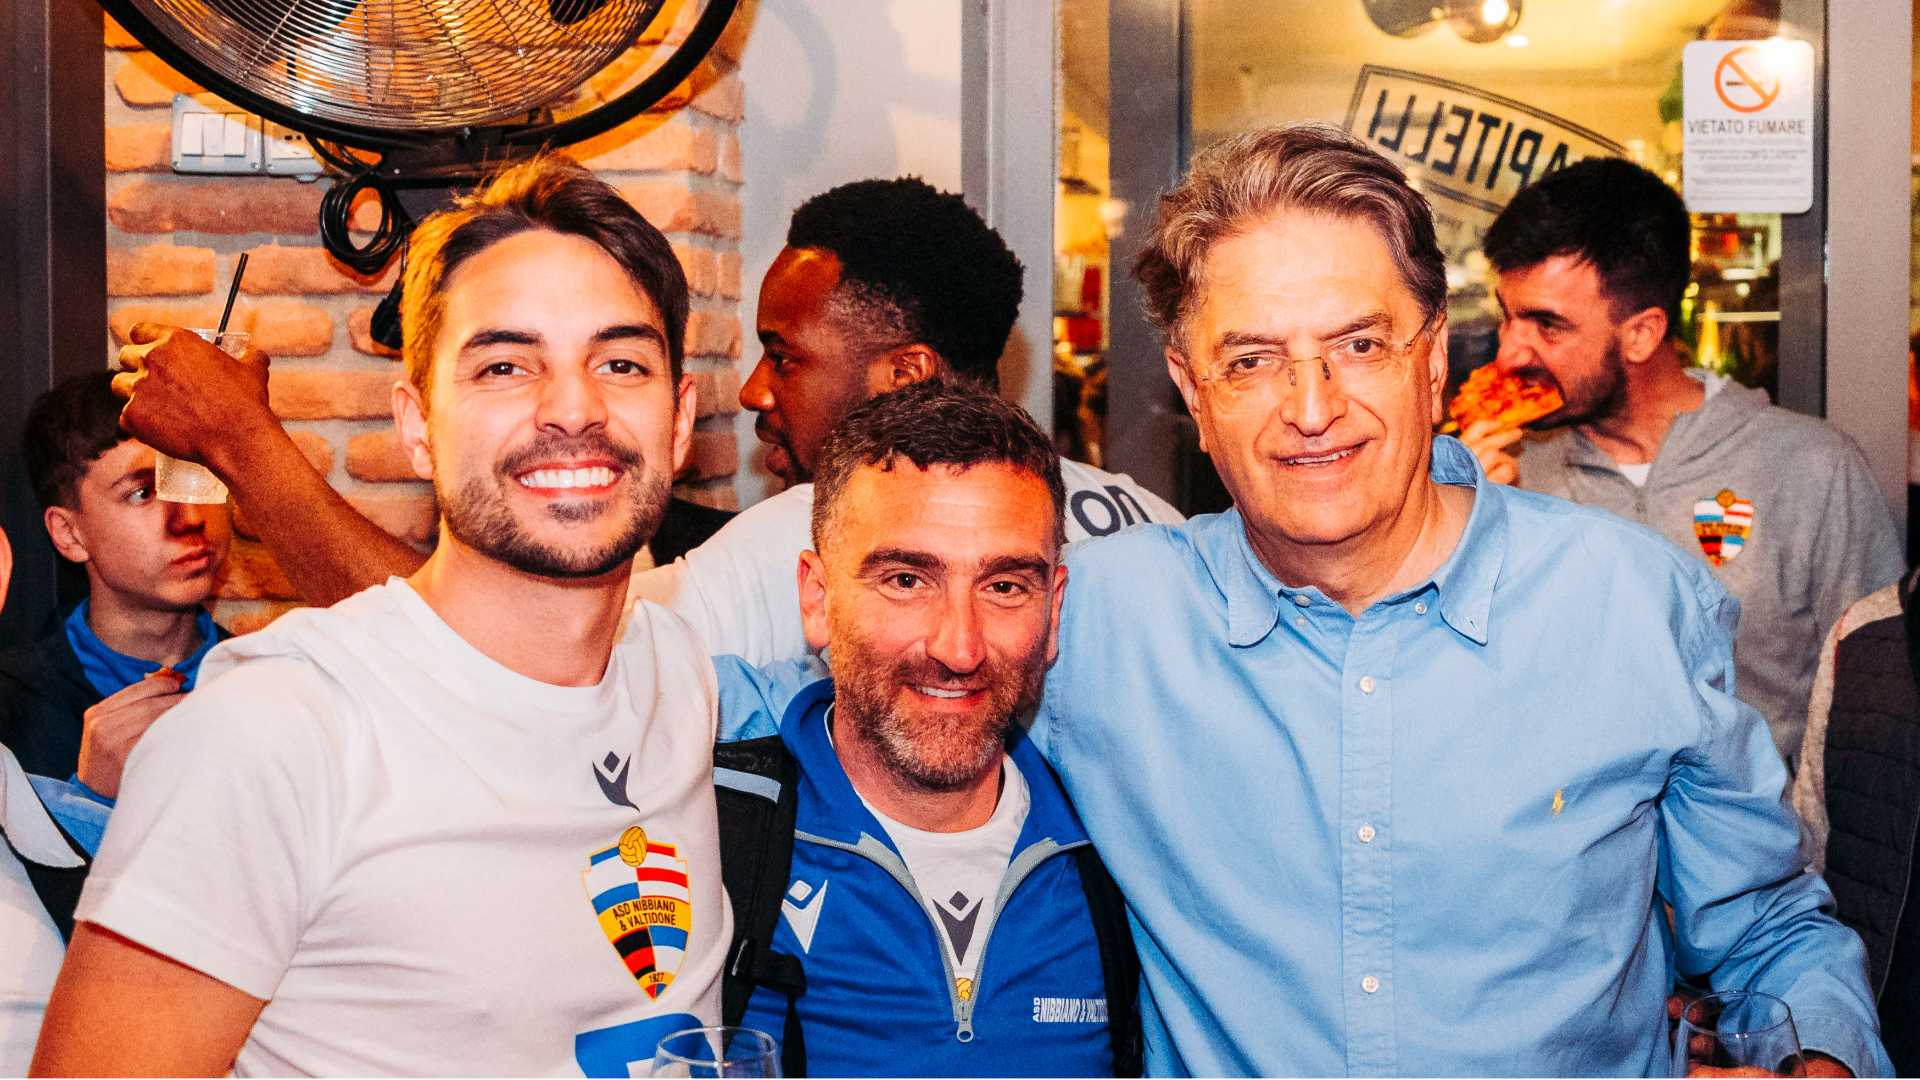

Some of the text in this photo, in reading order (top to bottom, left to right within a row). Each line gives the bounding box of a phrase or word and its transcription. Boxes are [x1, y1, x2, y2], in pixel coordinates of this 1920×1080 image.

[1688, 119, 1806, 134] VIETATO FUMARE
[612, 899, 676, 920] ASD NIBBIANO
[619, 912, 677, 931] & VALTIDONE
[648, 972, 665, 983] 1927
[1032, 997, 1040, 1022] ASD
[1040, 998, 1080, 1023] NIBBIANO
[1079, 998, 1086, 1023] &
